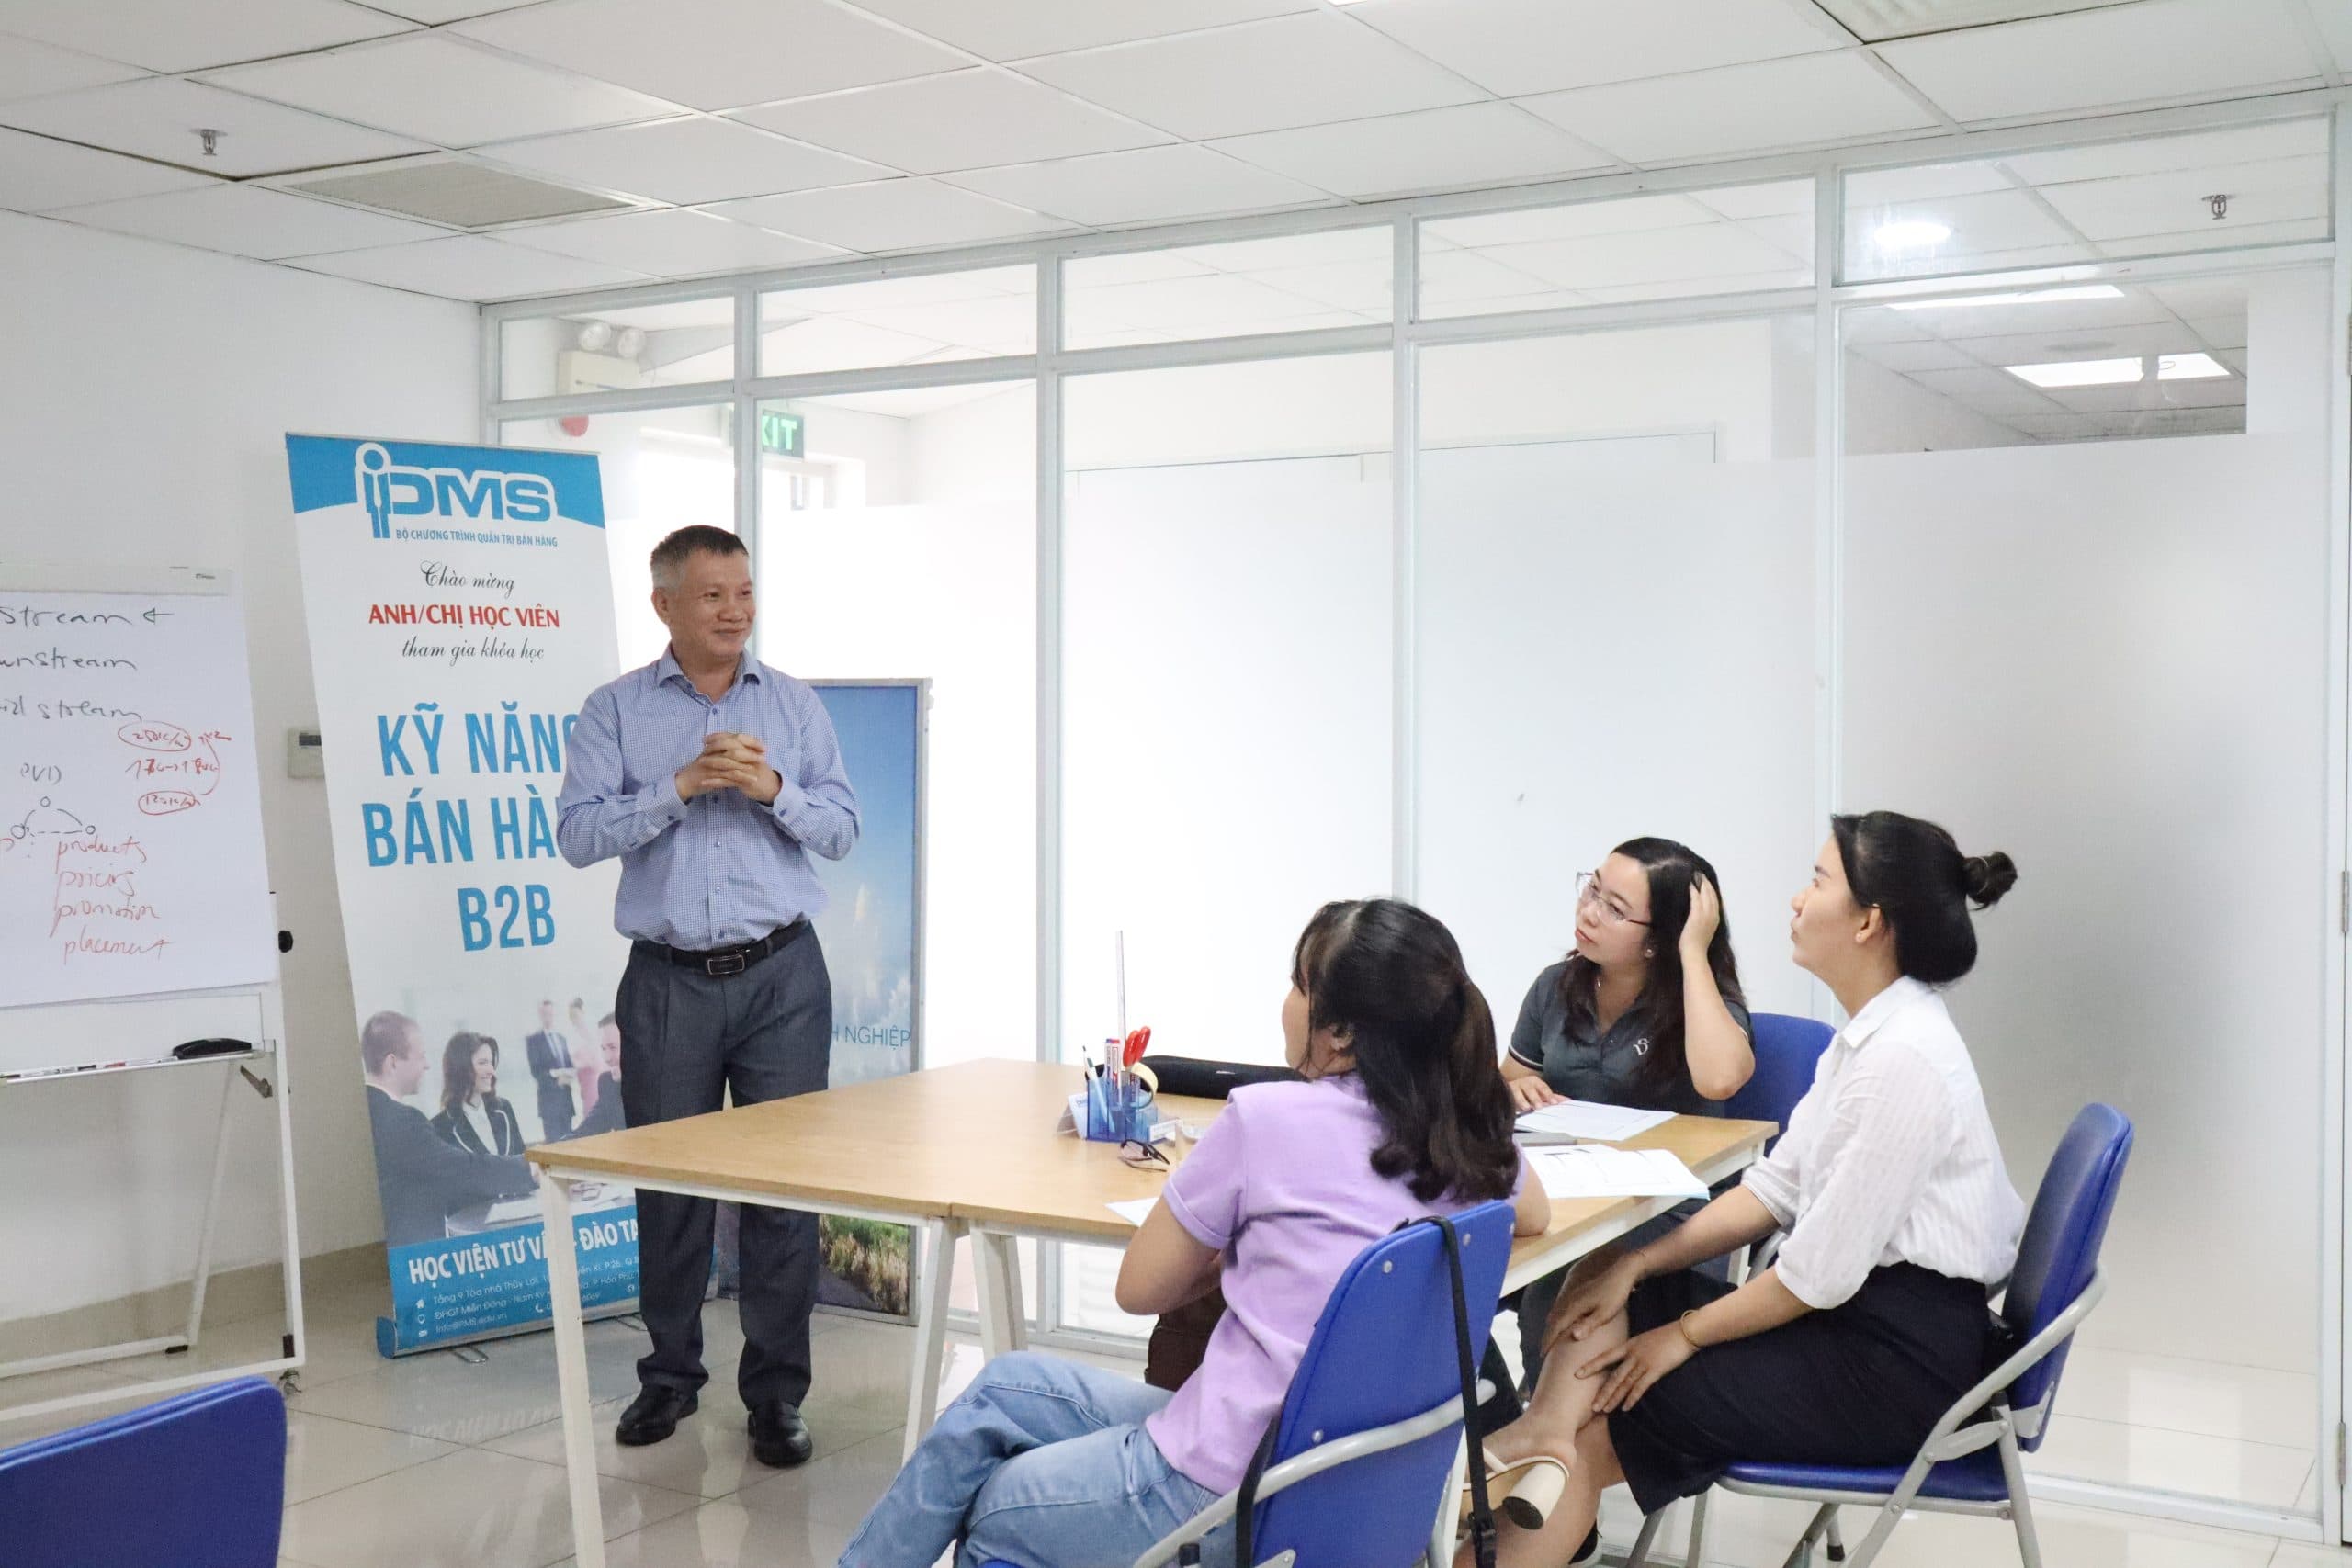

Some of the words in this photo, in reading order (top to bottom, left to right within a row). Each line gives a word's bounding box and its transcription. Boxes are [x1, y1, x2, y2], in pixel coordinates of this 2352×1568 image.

[762, 415, 797, 450] XIT
[396, 528, 409, 542] BỘ
[420, 560, 467, 587] Chào
[472, 572, 514, 599] mừng
[368, 604, 463, 629] ANH/CHỊ
[469, 605, 511, 630] HỌC
[515, 603, 560, 628] VIÊN
[401, 636, 446, 658] tham
[449, 639, 476, 667] gia
[481, 637, 515, 658] khóa
[520, 637, 545, 664] học
[377, 701, 444, 776] KỸ
[465, 701, 579, 773] NĂN
[362, 787, 474, 867] BÁN
[491, 784, 560, 860] HÀ
[457, 884, 555, 952] B2B
[844, 1024, 911, 1051] NGHIỆP
[408, 1253, 451, 1289] HỌC
[451, 1242, 500, 1279] VIỆN
[500, 1235, 526, 1266] TƯ
[578, 1221, 618, 1251] ĐÀO
